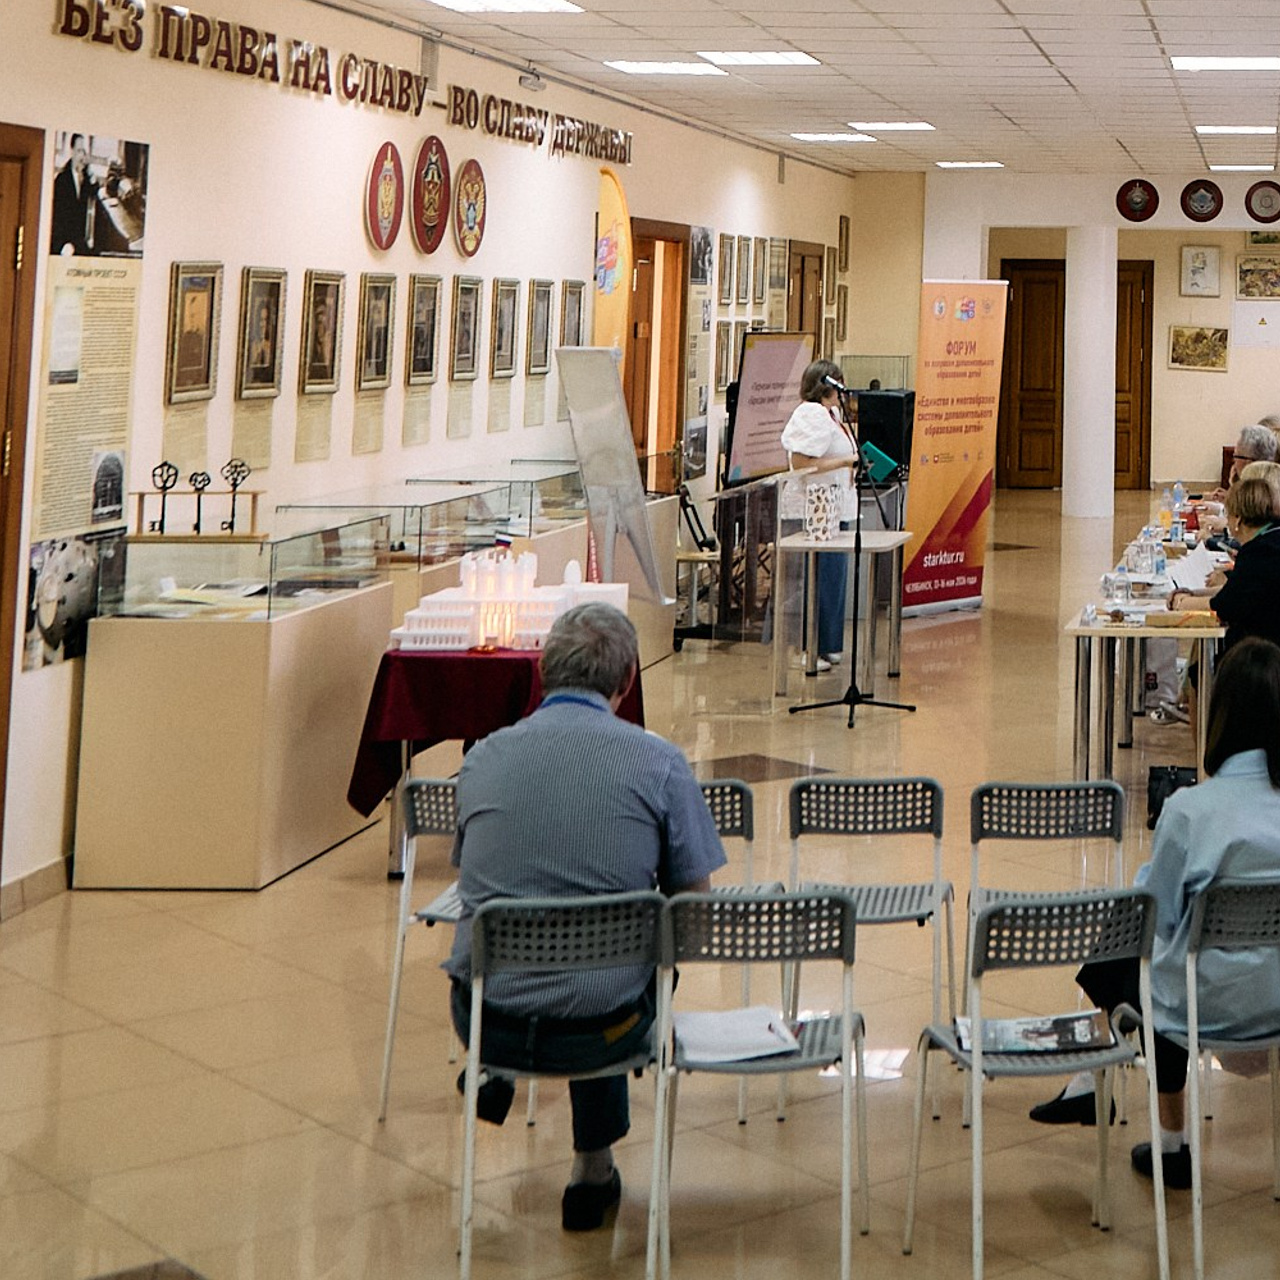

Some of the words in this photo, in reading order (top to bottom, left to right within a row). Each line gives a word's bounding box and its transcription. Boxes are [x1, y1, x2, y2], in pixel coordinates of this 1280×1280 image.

[158, 5, 280, 83] ПРАВА
[289, 39, 332, 95] НА
[340, 53, 428, 117] СЛАВУ
[450, 85, 480, 129] ВО
[484, 95, 549, 146] СЛАВУ
[551, 114, 634, 166] ДЕРЖАВЫ
[946, 340, 977, 355] ФОРУМ
[923, 550, 965, 568] starktur.ru
